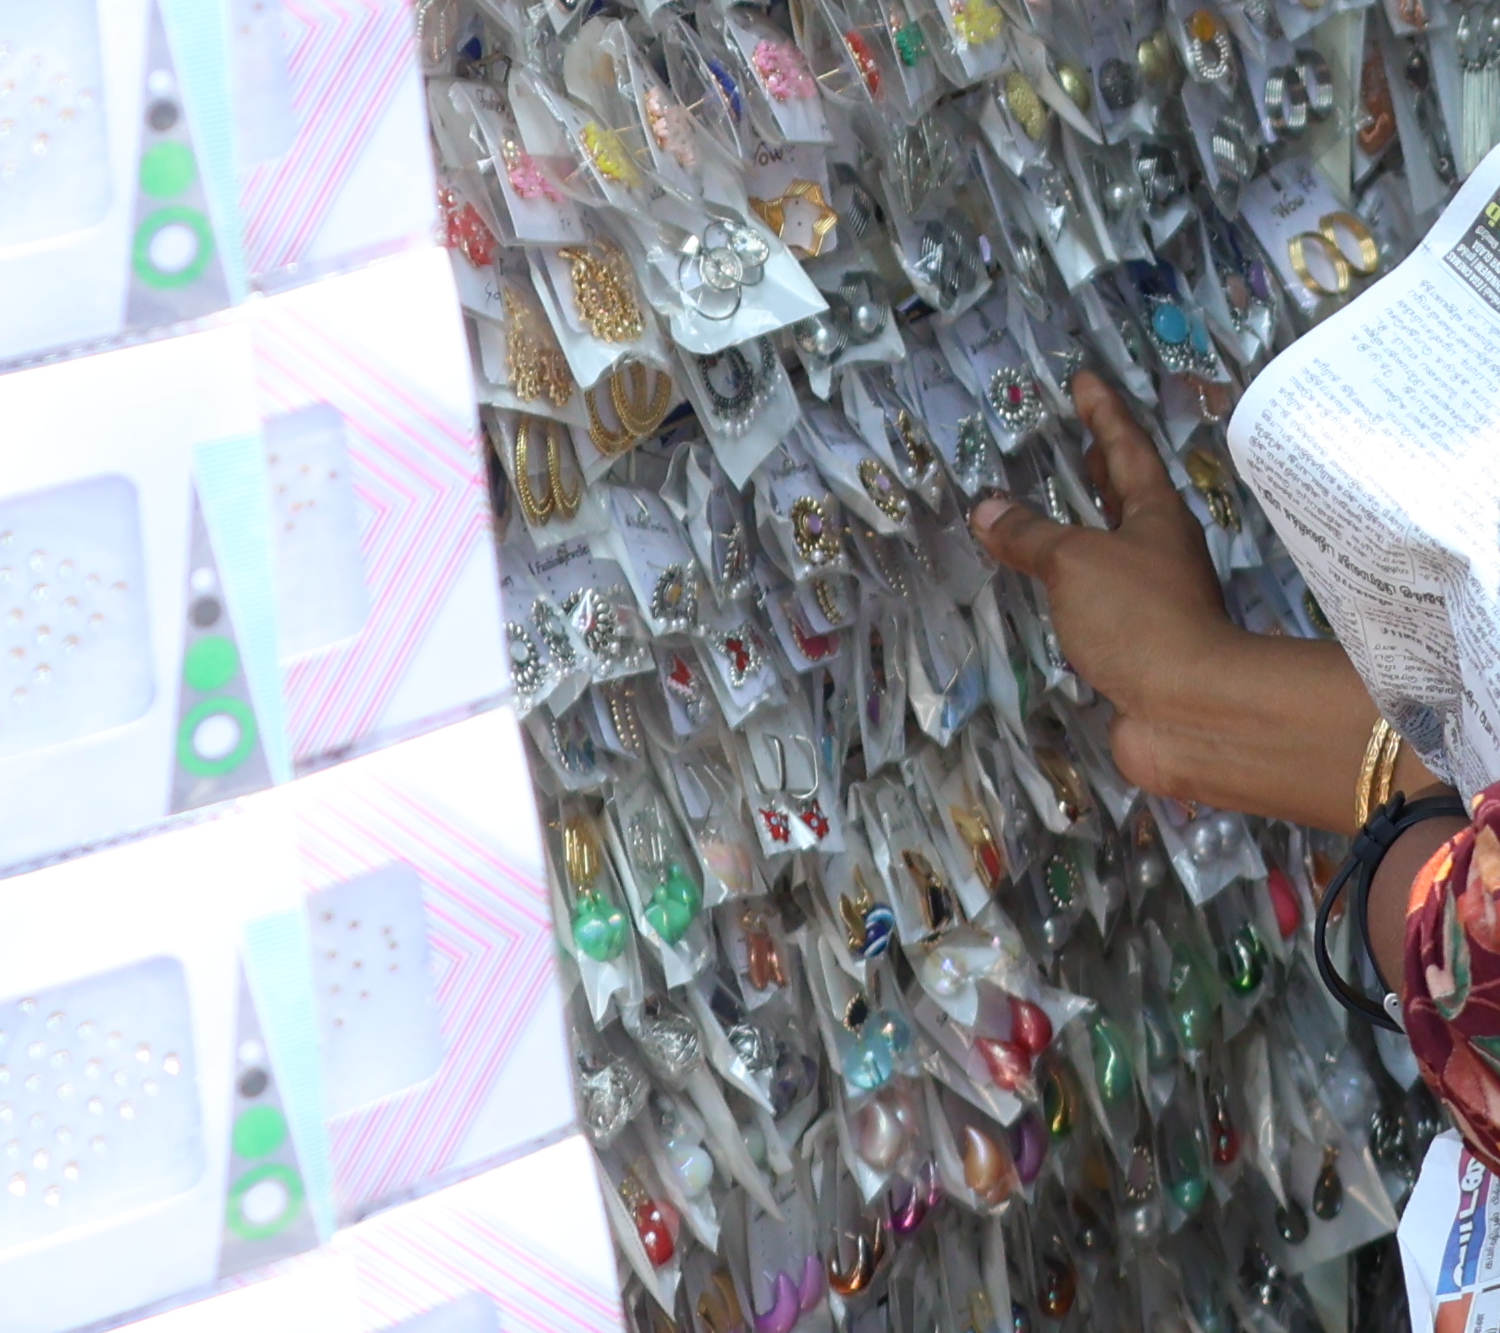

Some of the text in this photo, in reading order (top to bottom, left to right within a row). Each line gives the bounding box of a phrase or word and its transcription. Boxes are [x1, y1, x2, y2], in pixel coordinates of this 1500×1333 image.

[1471, 239, 1493, 262] GLADA
[1446, 250, 1473, 277] CINEMAS
[1468, 273, 1483, 288] EGA
